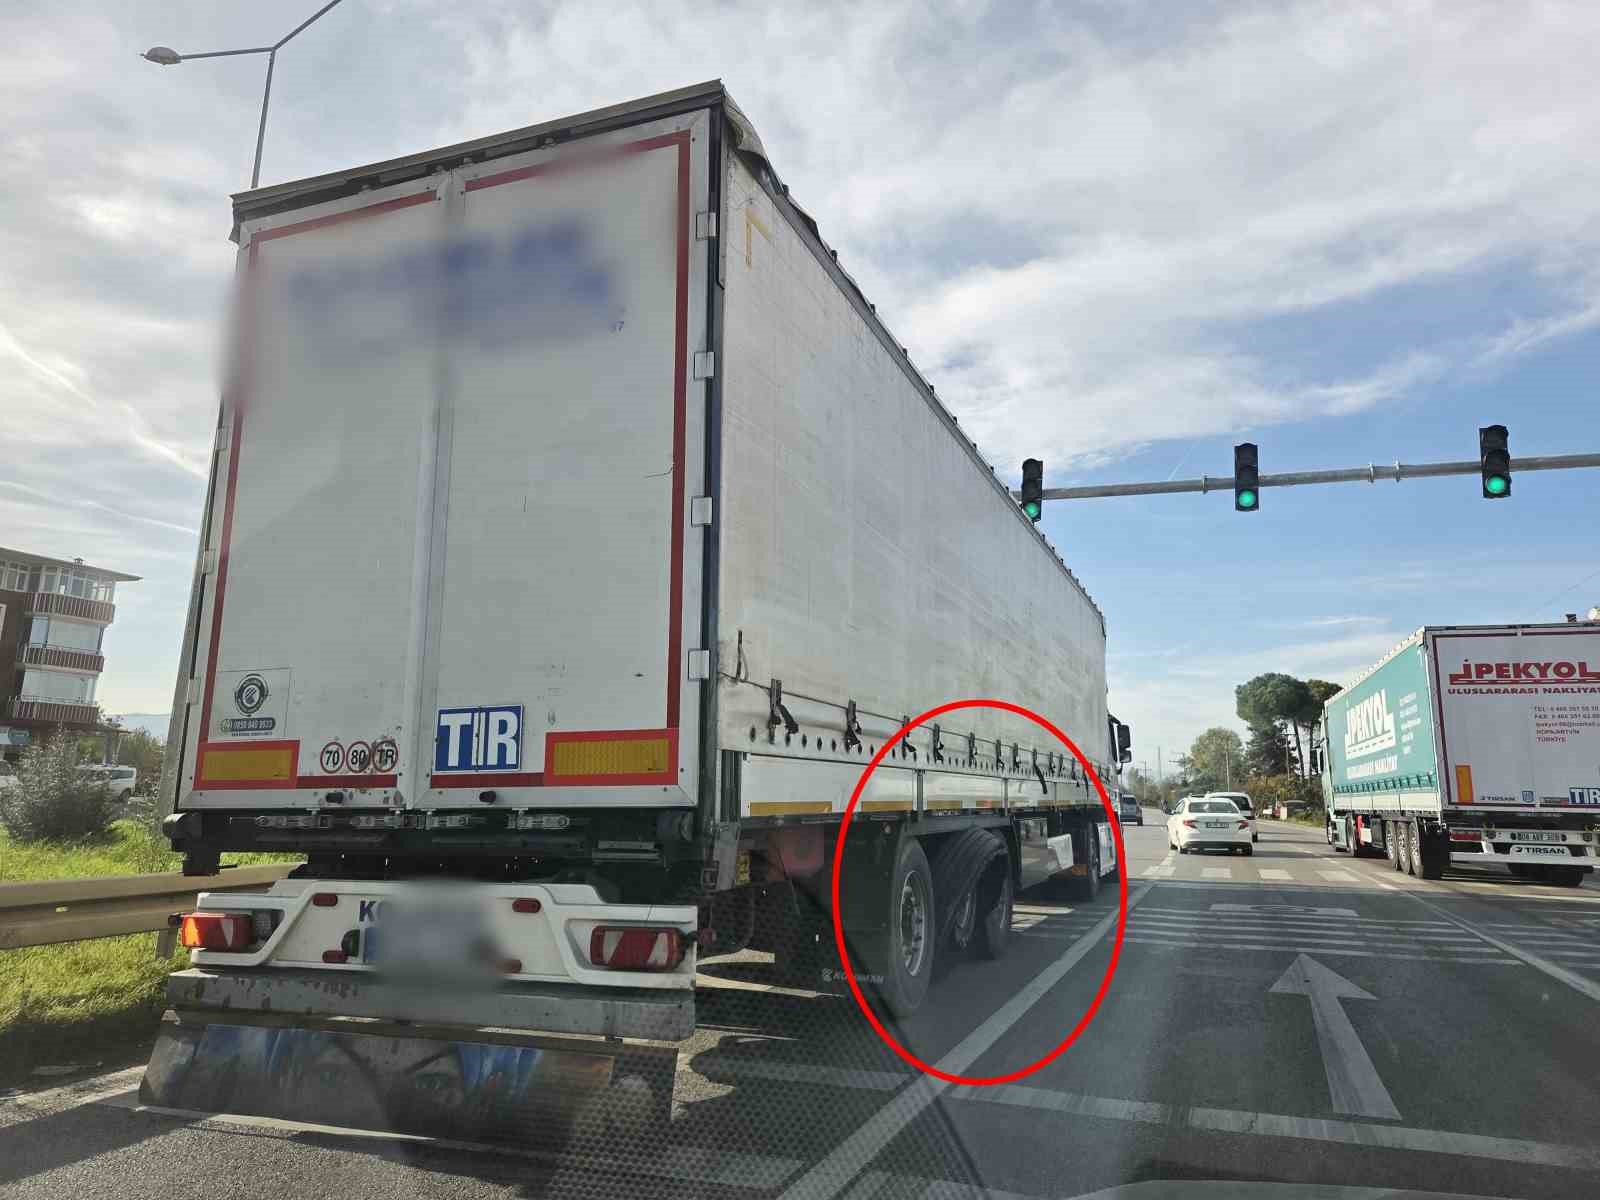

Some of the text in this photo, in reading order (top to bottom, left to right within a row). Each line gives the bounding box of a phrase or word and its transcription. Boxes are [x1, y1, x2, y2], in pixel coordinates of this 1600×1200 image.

[439, 711, 518, 767] TIR
[325, 750, 340, 766] 70
[350, 749, 366, 765] 80
[378, 749, 394, 766] TR
[1524, 847, 1565, 856] TIRSAN
